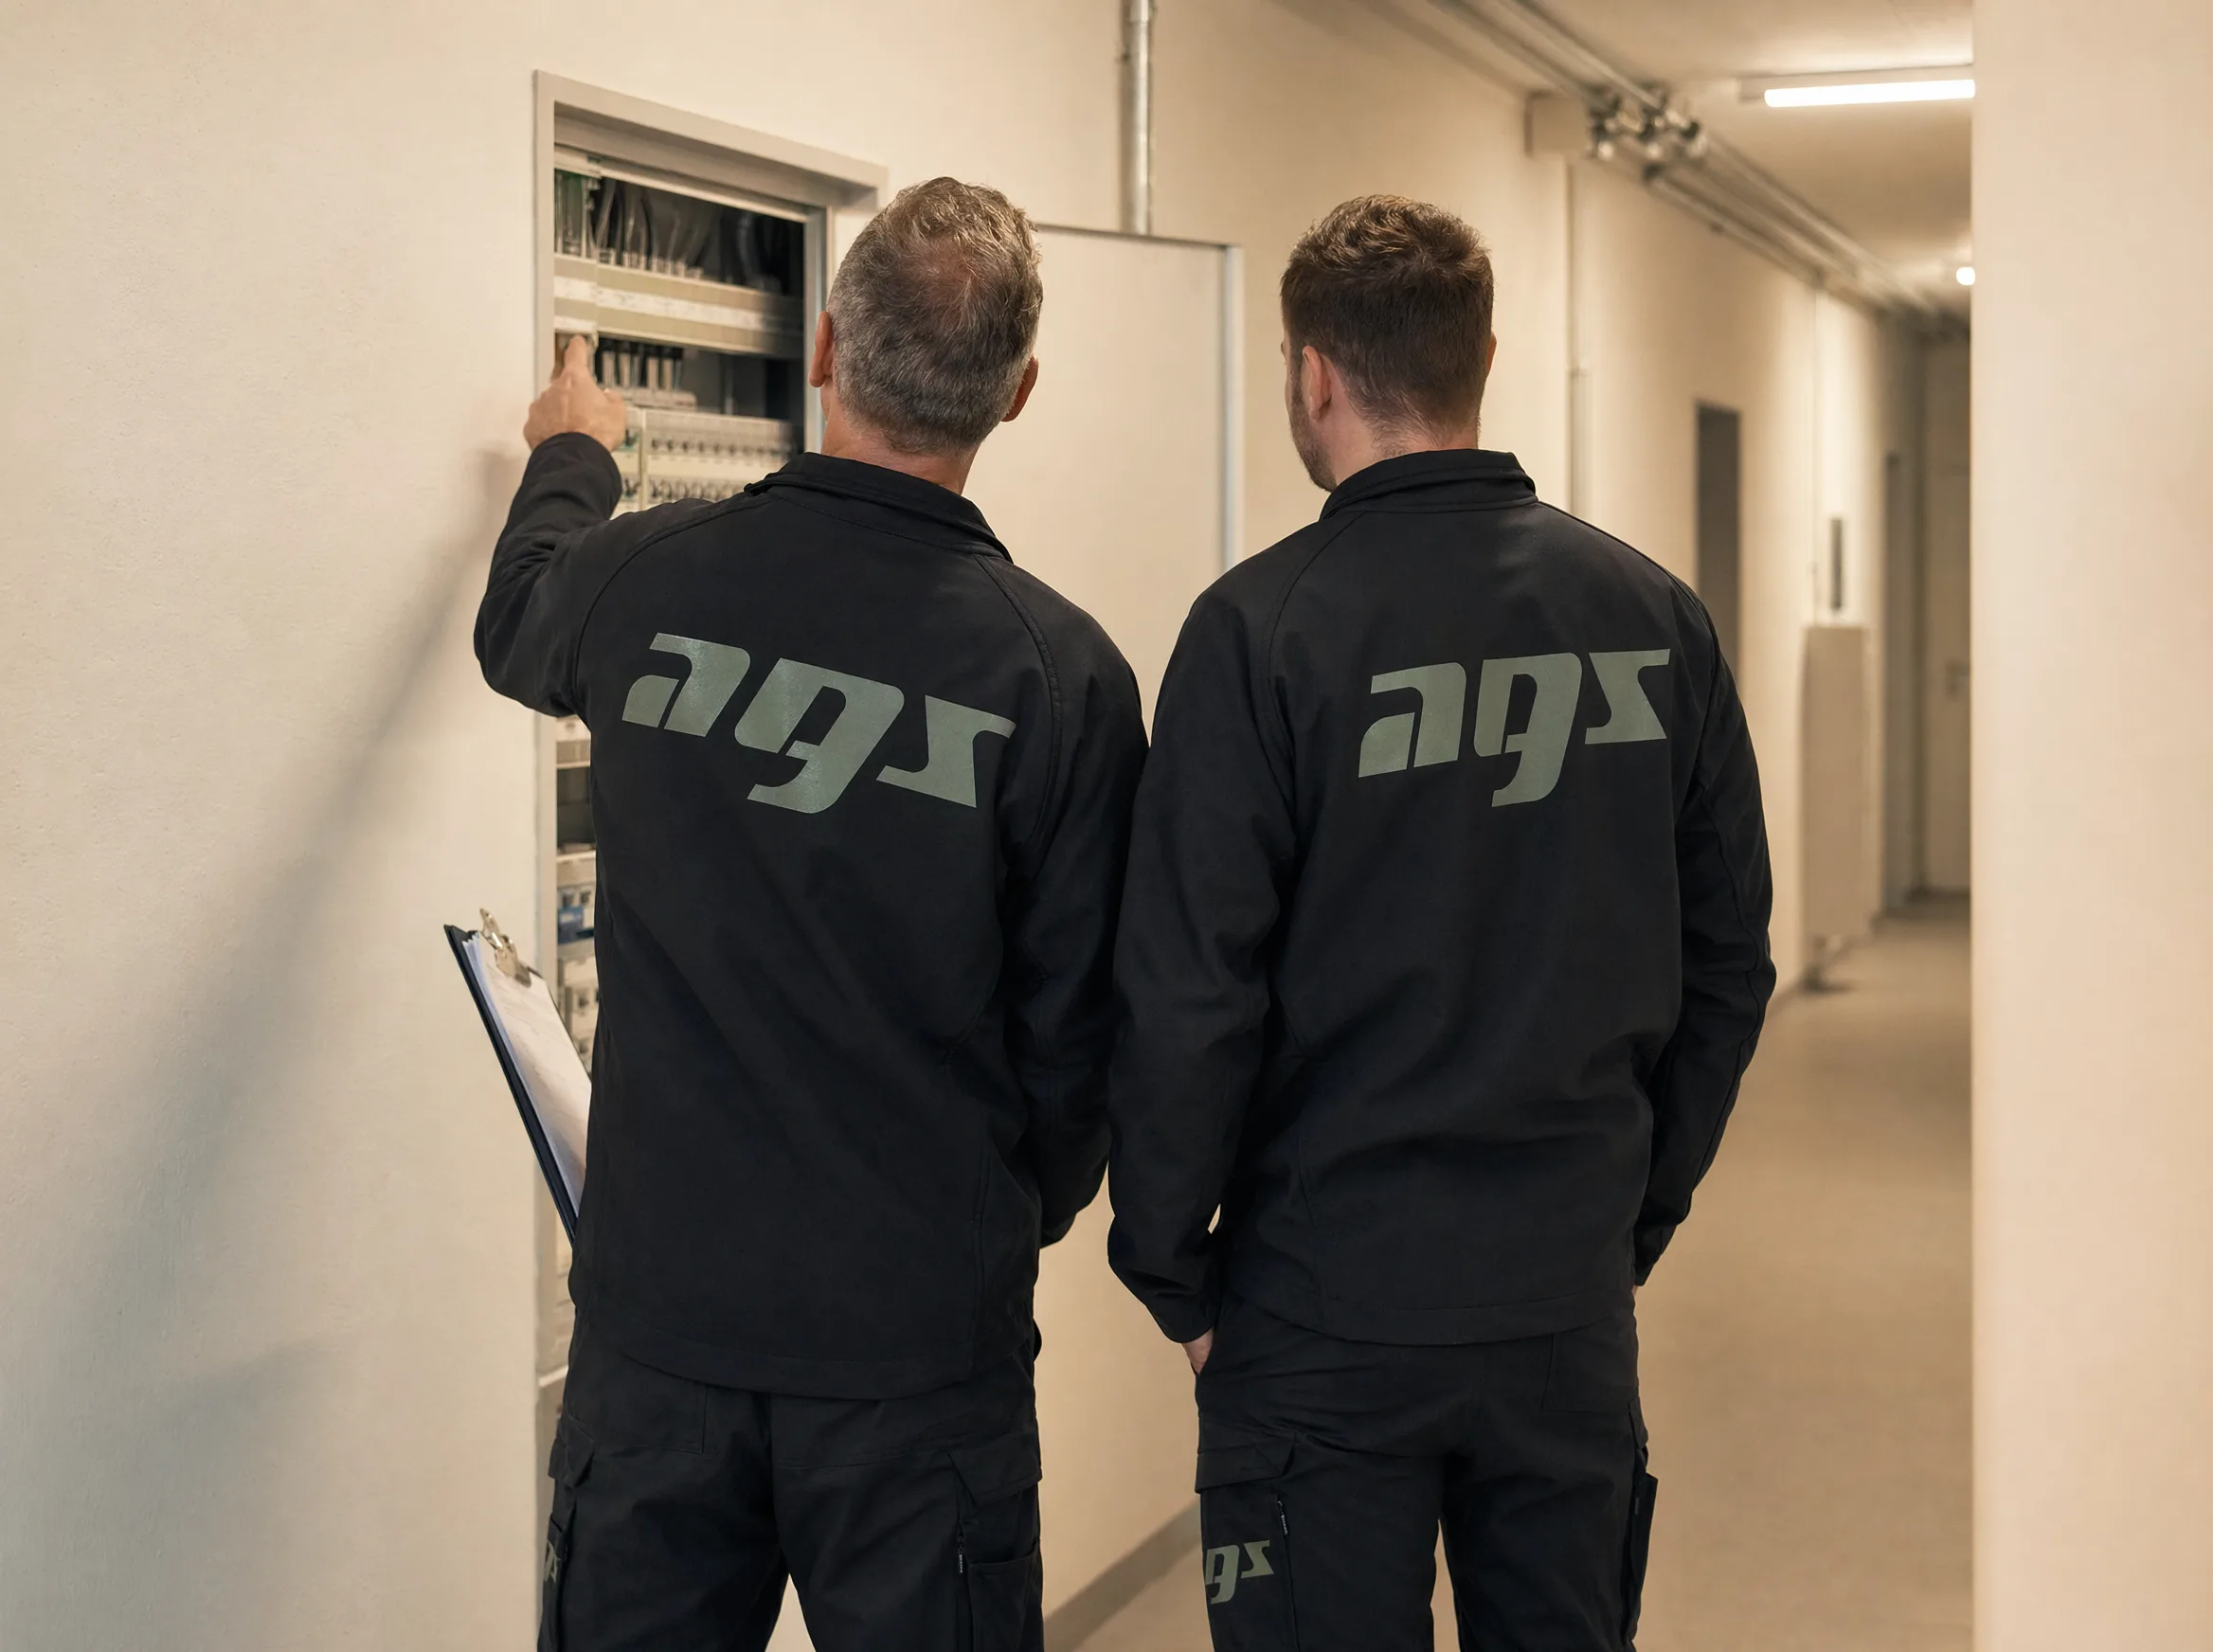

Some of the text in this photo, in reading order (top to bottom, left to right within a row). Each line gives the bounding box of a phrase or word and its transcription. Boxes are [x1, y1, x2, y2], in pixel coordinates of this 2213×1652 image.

[621, 632, 1017, 814] ags
[1358, 648, 1671, 807] ags
[1204, 1539, 1274, 1605] gs
